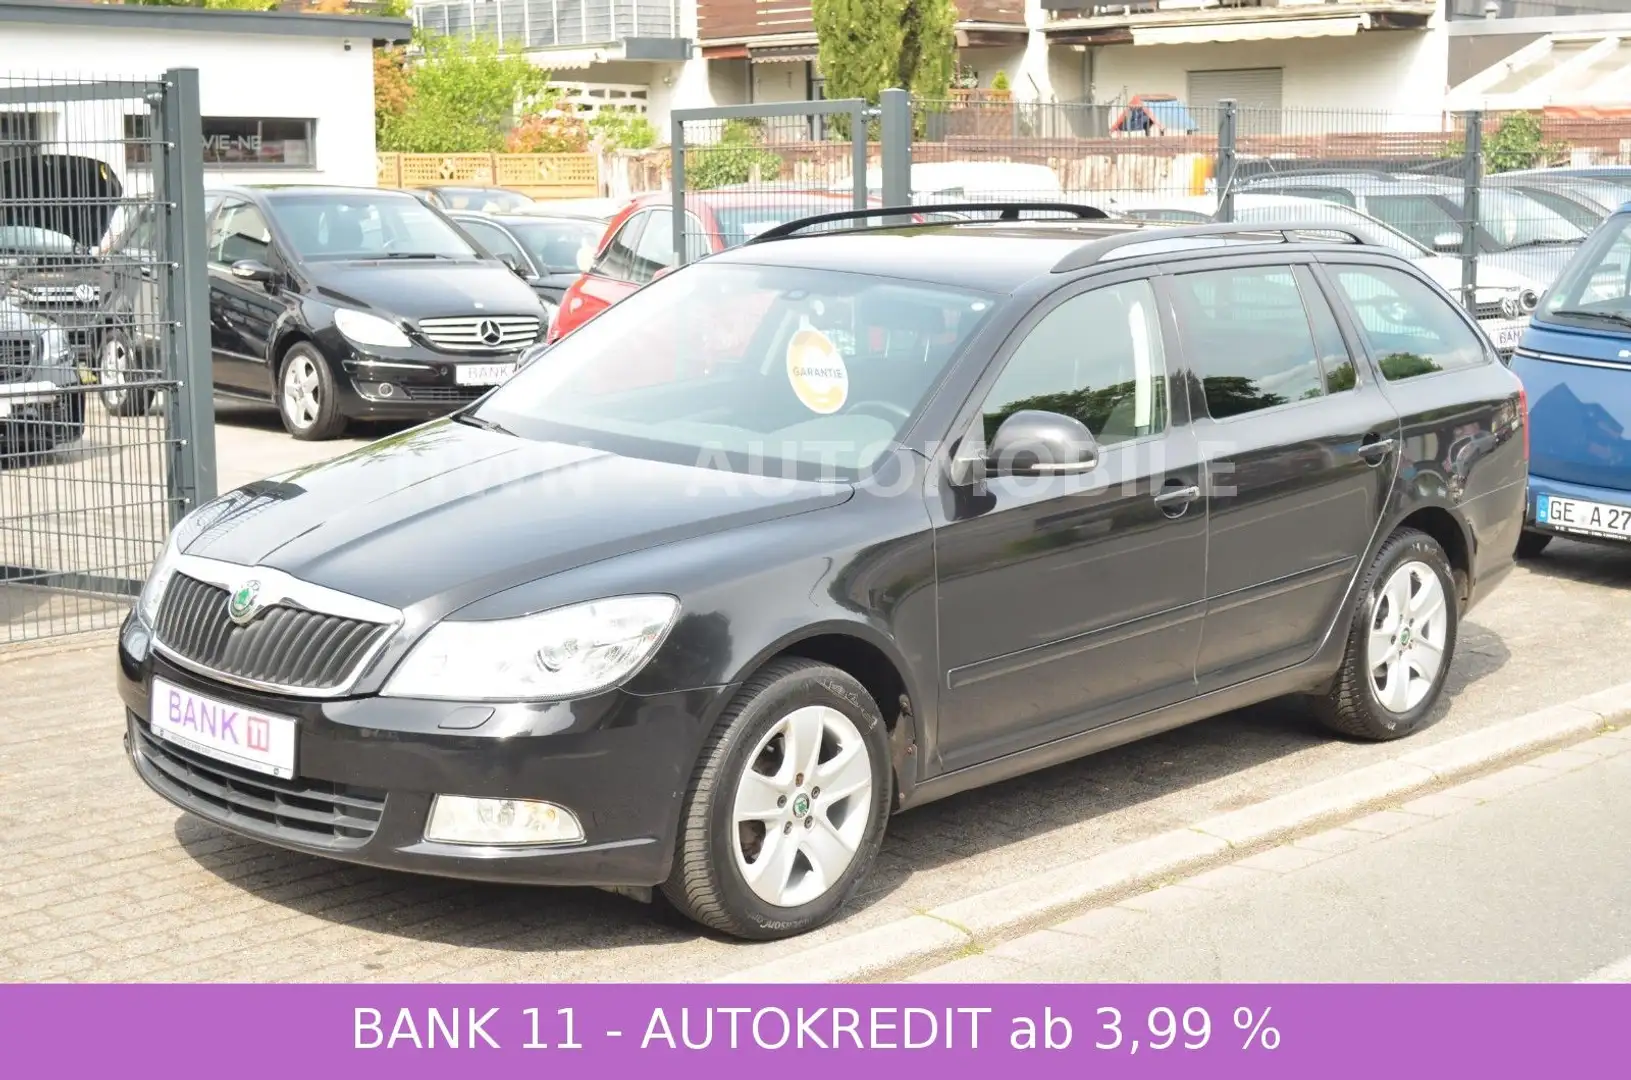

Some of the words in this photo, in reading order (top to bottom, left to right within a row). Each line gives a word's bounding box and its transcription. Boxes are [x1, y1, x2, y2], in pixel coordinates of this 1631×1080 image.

[792, 365, 843, 378] GARANTIE
[1550, 500, 1575, 523] GE
[1590, 506, 1602, 527] A
[1607, 508, 1631, 531] 27
[169, 690, 240, 745] BANK
